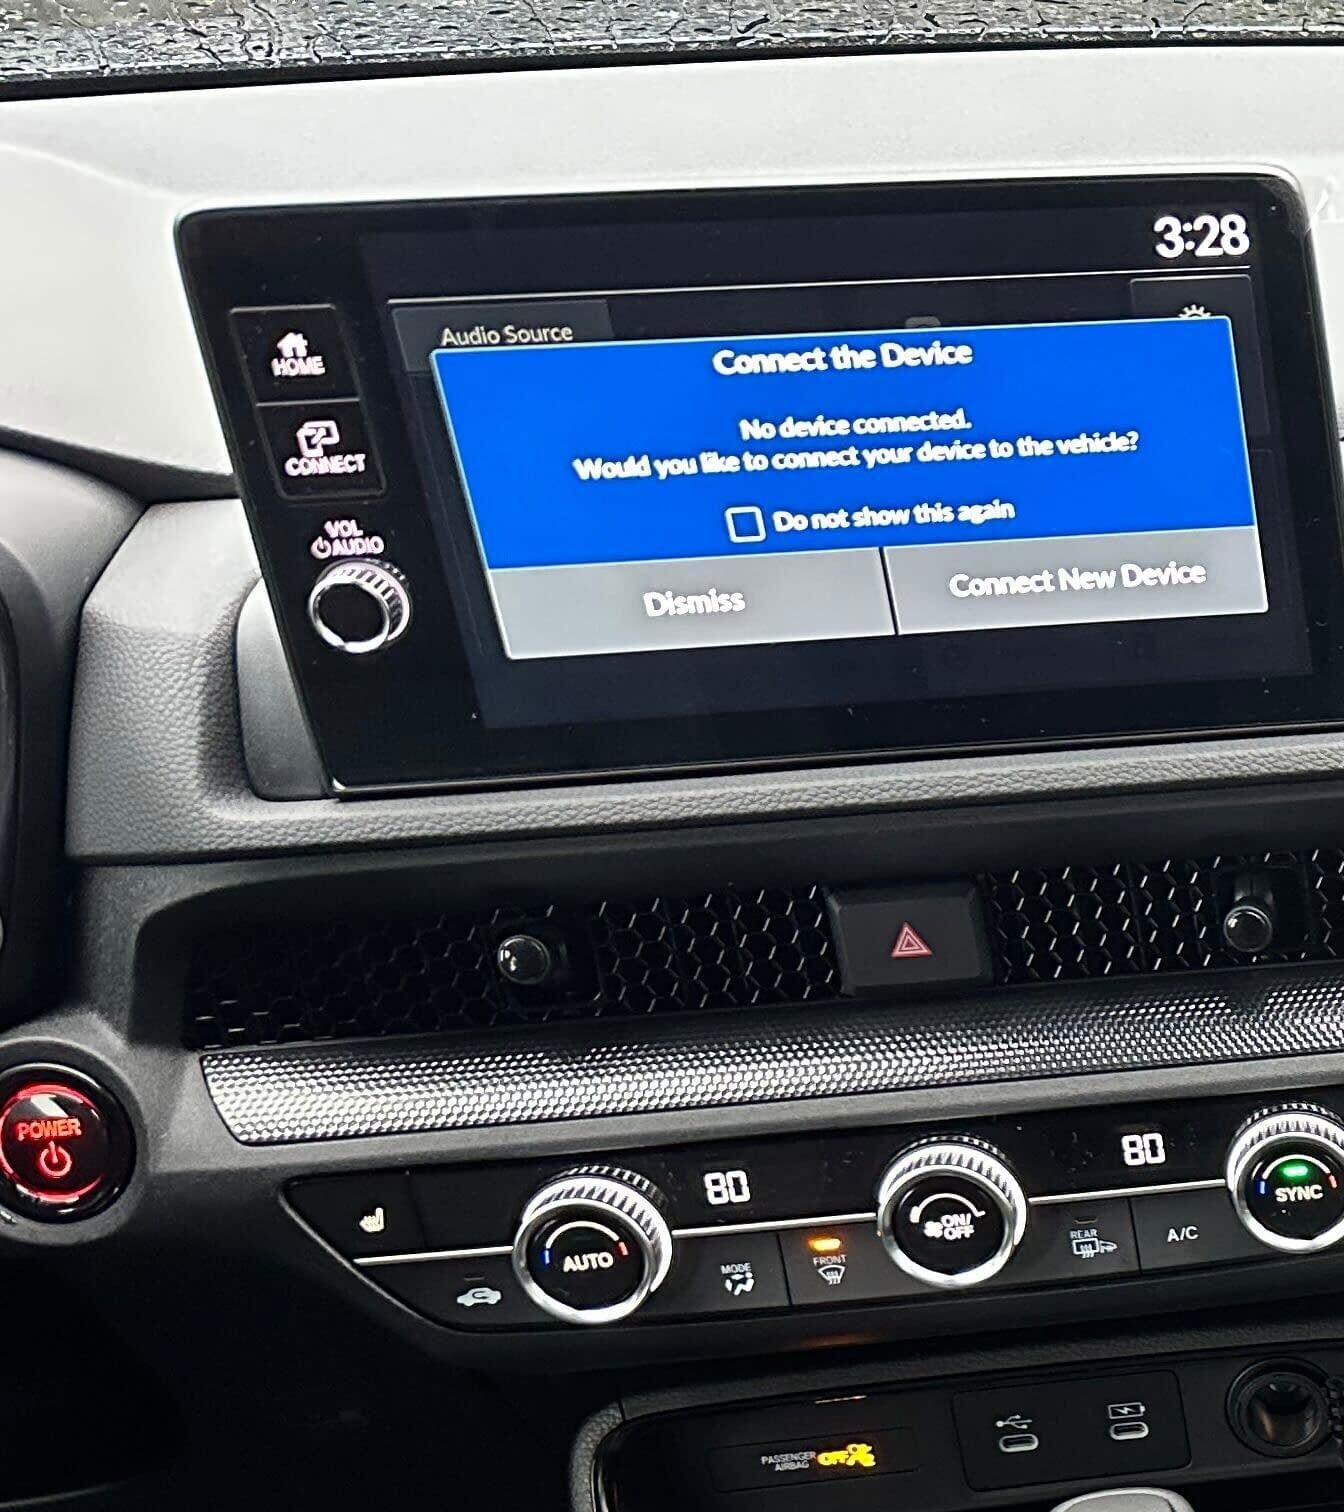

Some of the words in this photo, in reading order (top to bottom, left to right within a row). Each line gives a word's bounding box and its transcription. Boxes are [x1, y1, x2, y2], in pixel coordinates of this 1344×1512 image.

[1153, 213, 1250, 259] 3:28
[439, 326, 501, 348] Audio
[504, 323, 573, 343] Source
[271, 355, 325, 377] HOME
[711, 345, 828, 376] Connect
[830, 343, 877, 370] the
[880, 339, 973, 369] Device
[738, 417, 777, 441] No
[779, 414, 850, 439] device
[853, 407, 972, 434] connected.
[285, 453, 366, 477] CONNECT
[571, 454, 652, 480] Would
[653, 456, 698, 480] you
[699, 452, 741, 474] like
[742, 451, 769, 472] to
[771, 445, 862, 469] connect
[863, 445, 913, 470] your
[915, 439, 987, 463] device
[988, 438, 1015, 459] to
[1016, 435, 1054, 457] the
[1056, 430, 1140, 454] vehicle?
[772, 509, 809, 533] Do
[810, 509, 850, 530] not
[851, 505, 912, 527] show
[912, 501, 955, 523] this
[956, 498, 1016, 526] again
[324, 518, 363, 539] VOL
[331, 535, 385, 557] AUDIO
[949, 569, 1055, 599] Connect
[1057, 566, 1117, 592] New
[1120, 560, 1207, 588] Device
[643, 588, 746, 617] Dismiss
[14, 1116, 83, 1142] POWER
[1120, 1132, 1167, 1167] 80
[703, 1169, 751, 1206] 80
[1274, 1184, 1325, 1203] SYNC
[941, 1212, 972, 1228] ON/
[943, 1225, 975, 1241] OFF
[1069, 1228, 1099, 1240] REAR
[1166, 1225, 1200, 1244] A/C
[561, 1250, 615, 1274] AUTO
[720, 1262, 752, 1275] MODE
[812, 1254, 848, 1267] FRONT
[761, 1450, 816, 1466] PASSENGER
[774, 1460, 810, 1472] AIRBAG
